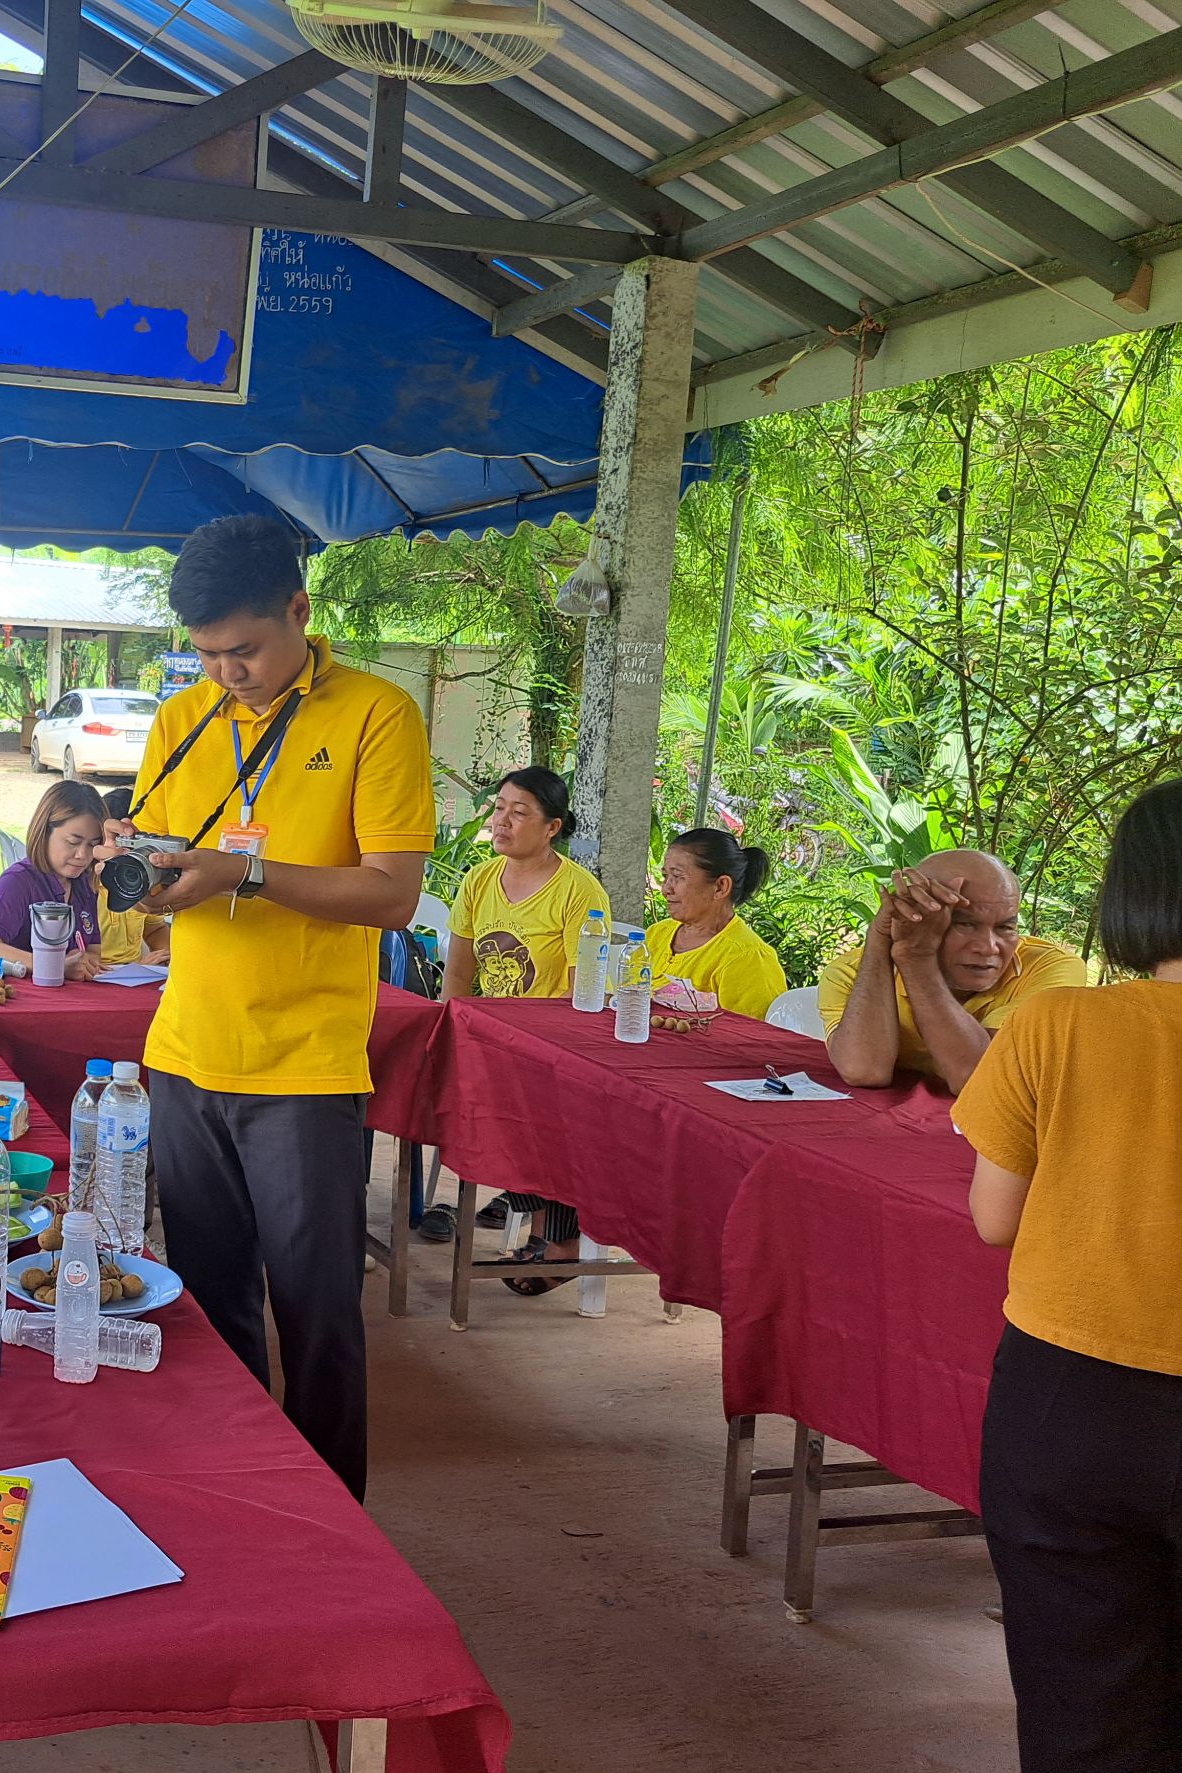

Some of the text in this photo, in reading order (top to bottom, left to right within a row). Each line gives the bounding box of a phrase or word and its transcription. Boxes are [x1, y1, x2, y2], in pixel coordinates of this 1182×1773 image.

[283, 265, 352, 291] หน่อแก้ว
[288, 295, 333, 315] 2559
[304, 761, 333, 771] adidas
